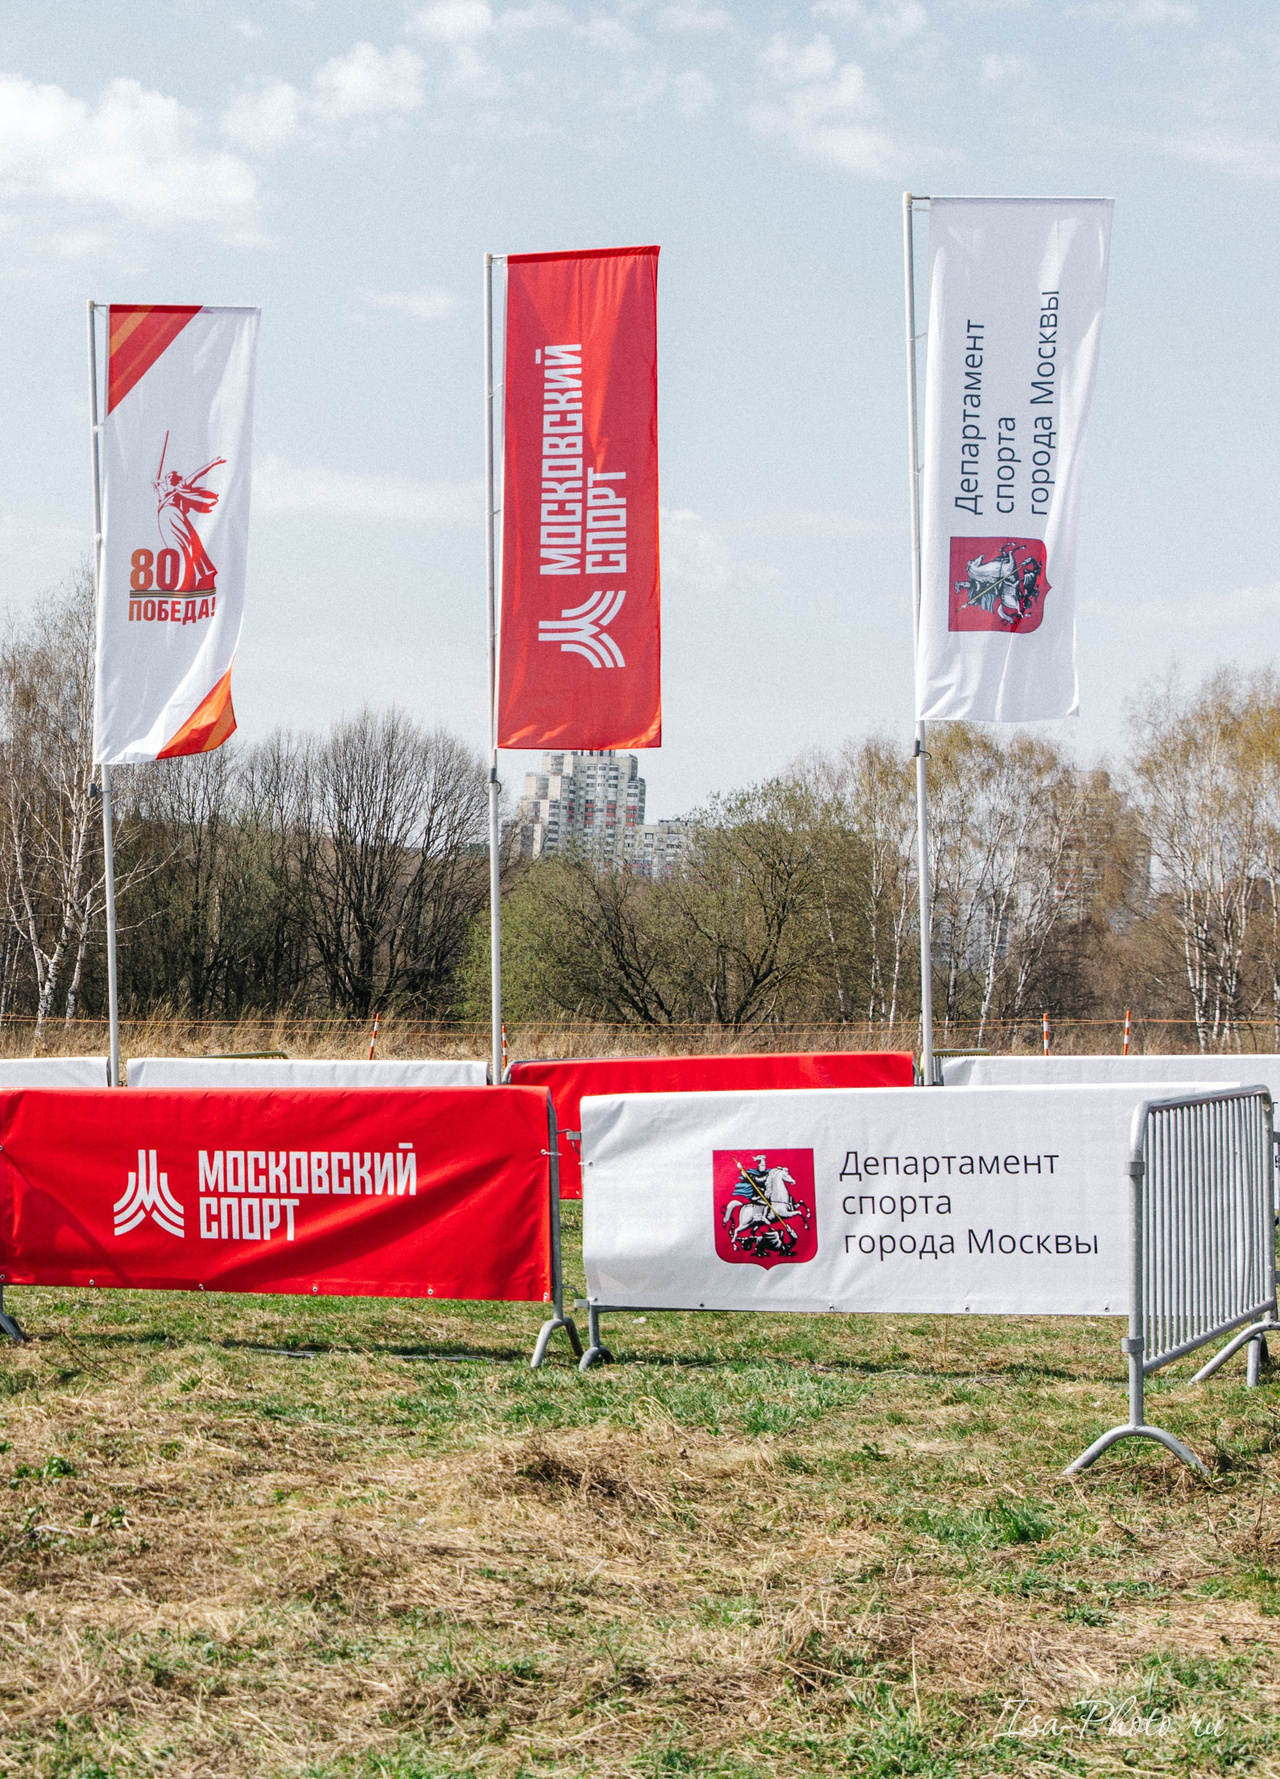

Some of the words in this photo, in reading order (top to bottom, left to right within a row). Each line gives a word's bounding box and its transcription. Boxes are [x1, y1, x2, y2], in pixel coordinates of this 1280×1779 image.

[1029, 290, 1060, 405] Москвы
[954, 319, 987, 516] Департамент
[535, 343, 582, 576] МОСКОВСКИЙ
[996, 416, 1022, 514] спорта
[1030, 415, 1057, 516] города
[585, 467, 627, 574] СПОРТ
[129, 548, 180, 591] 80
[128, 596, 216, 625] ПОБЕДА!
[198, 1142, 417, 1196] МОСКОВСКИЙ
[839, 1151, 1059, 1183] Департамент
[200, 1197, 300, 1241] СПОРТ
[842, 1194, 951, 1222] спорта
[844, 1233, 955, 1261] города
[967, 1228, 1099, 1255] Москвы
